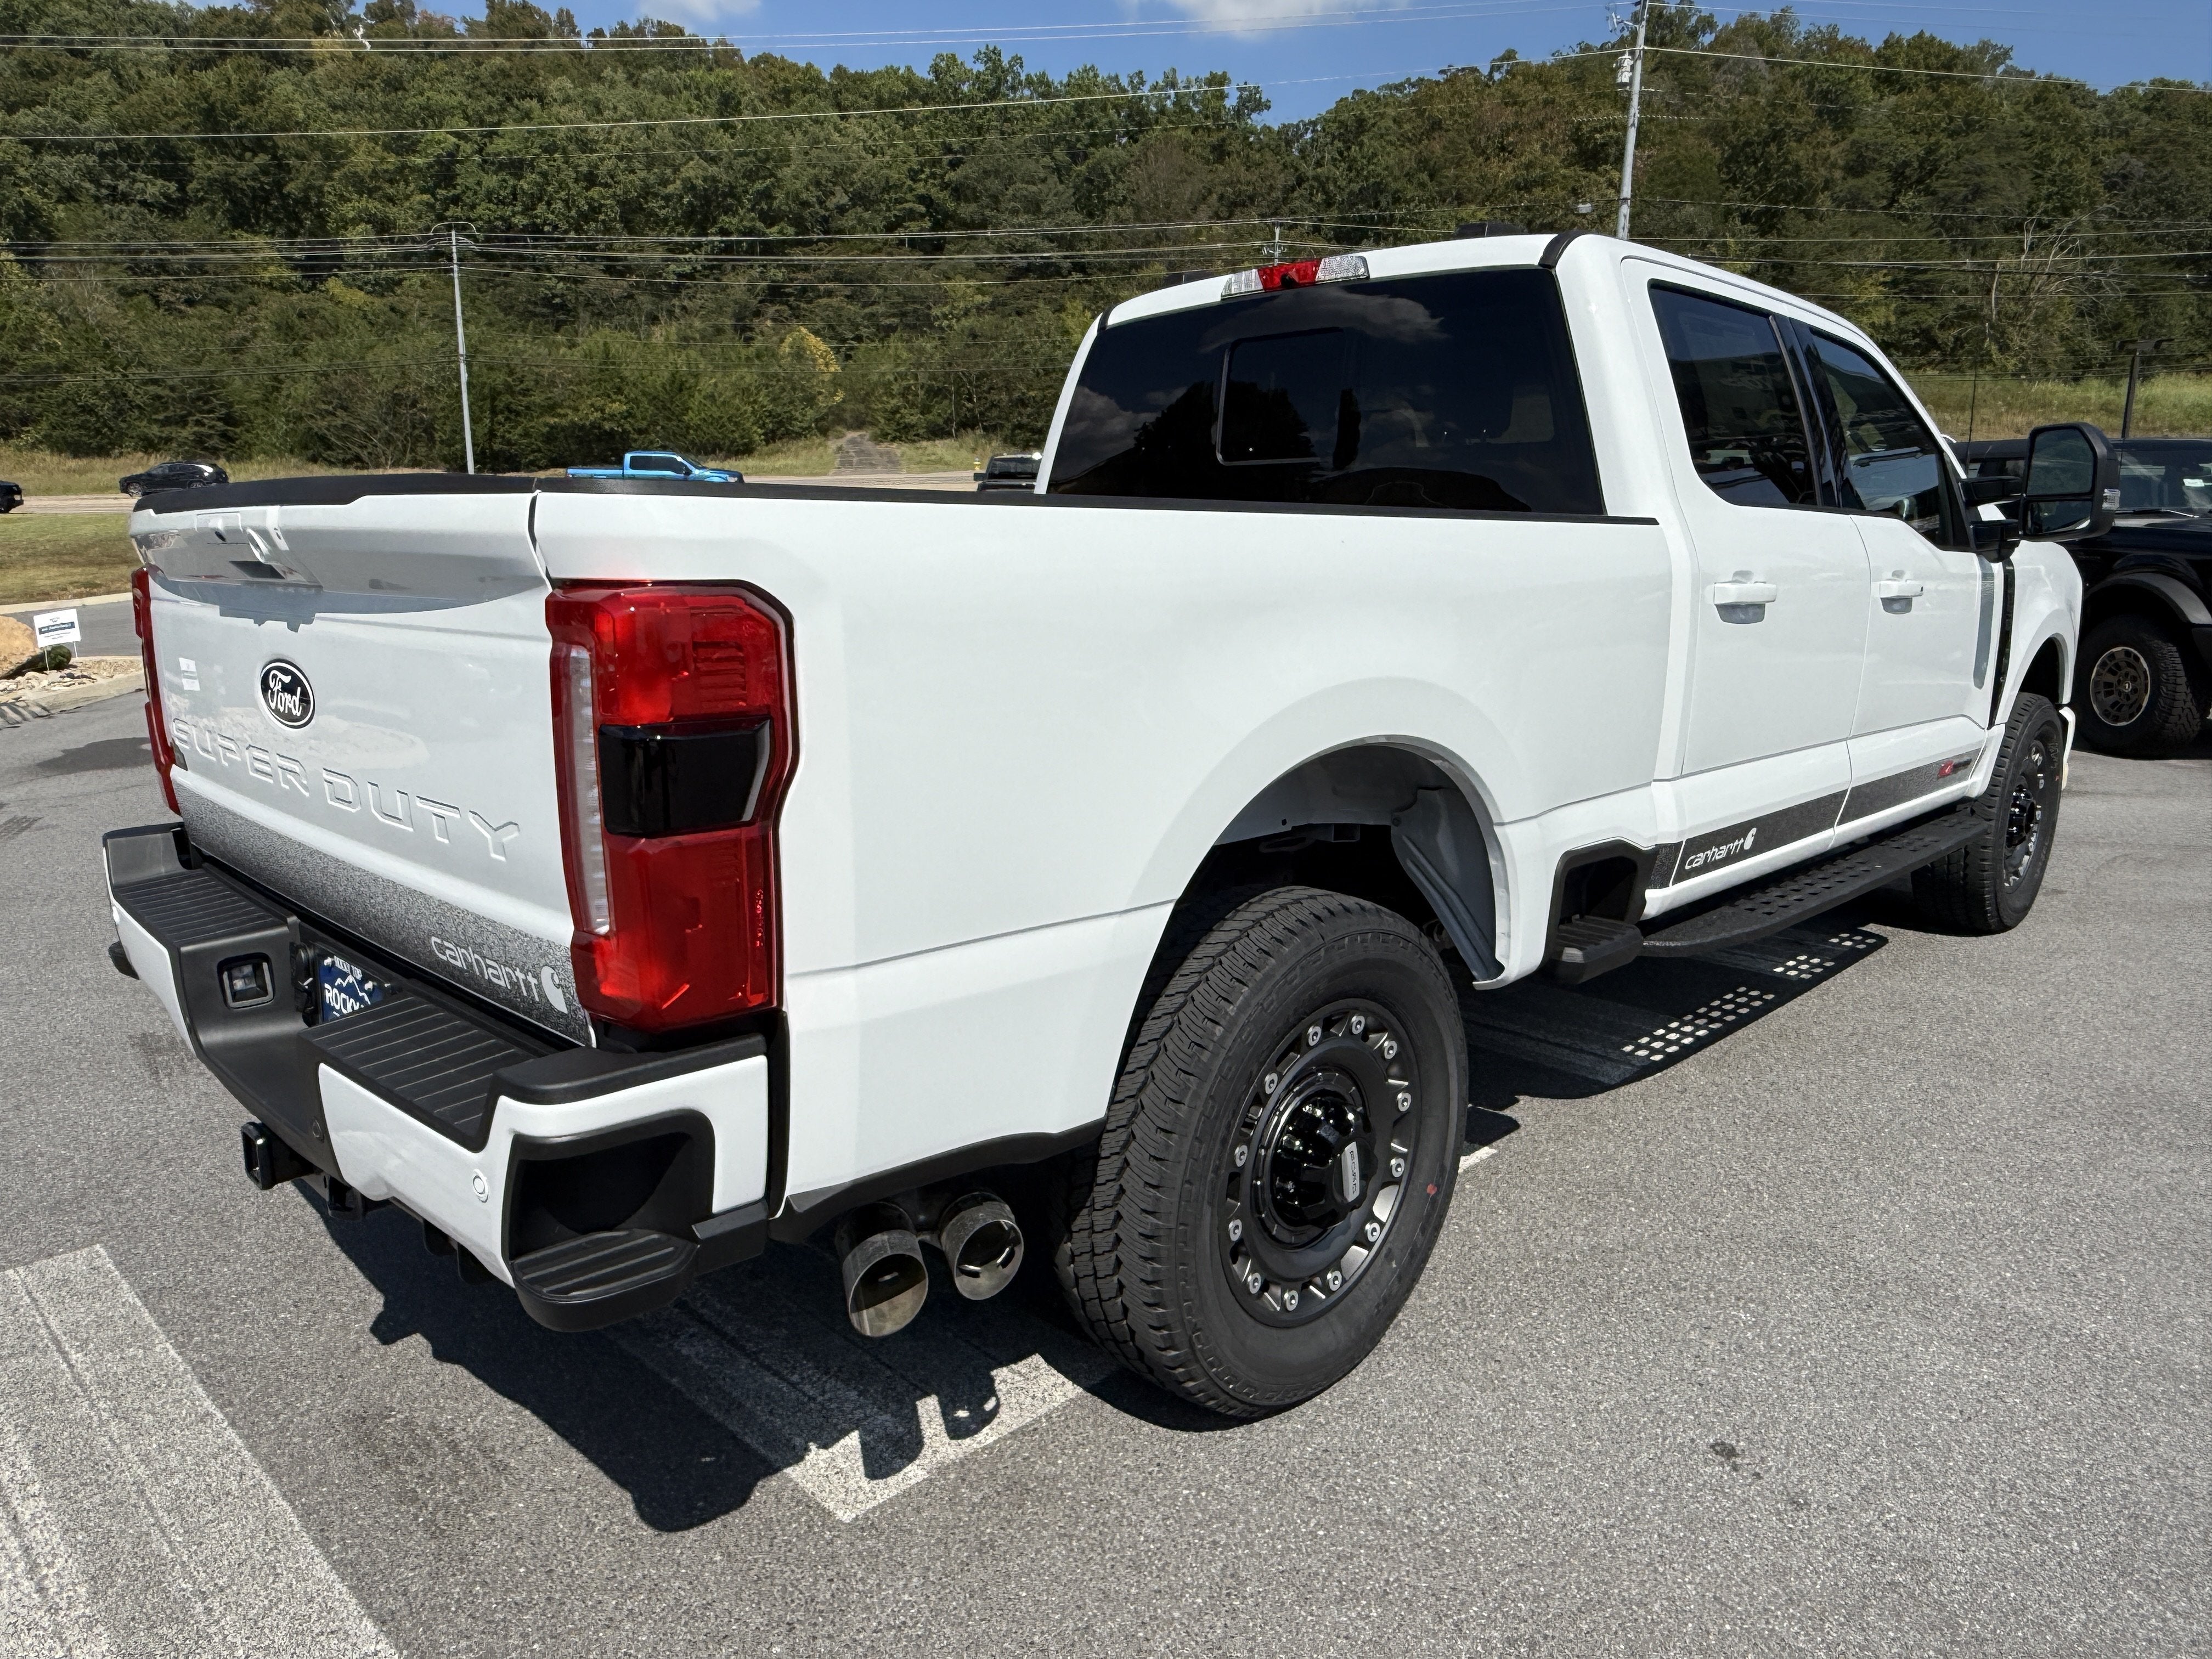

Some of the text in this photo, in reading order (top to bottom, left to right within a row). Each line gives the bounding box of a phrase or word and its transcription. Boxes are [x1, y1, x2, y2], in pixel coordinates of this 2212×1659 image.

[268, 670, 302, 716] Ford
[172, 718, 520, 862] SUPER DUTY
[1685, 837, 1744, 870] carhartt
[431, 936, 539, 1002] carhartt
